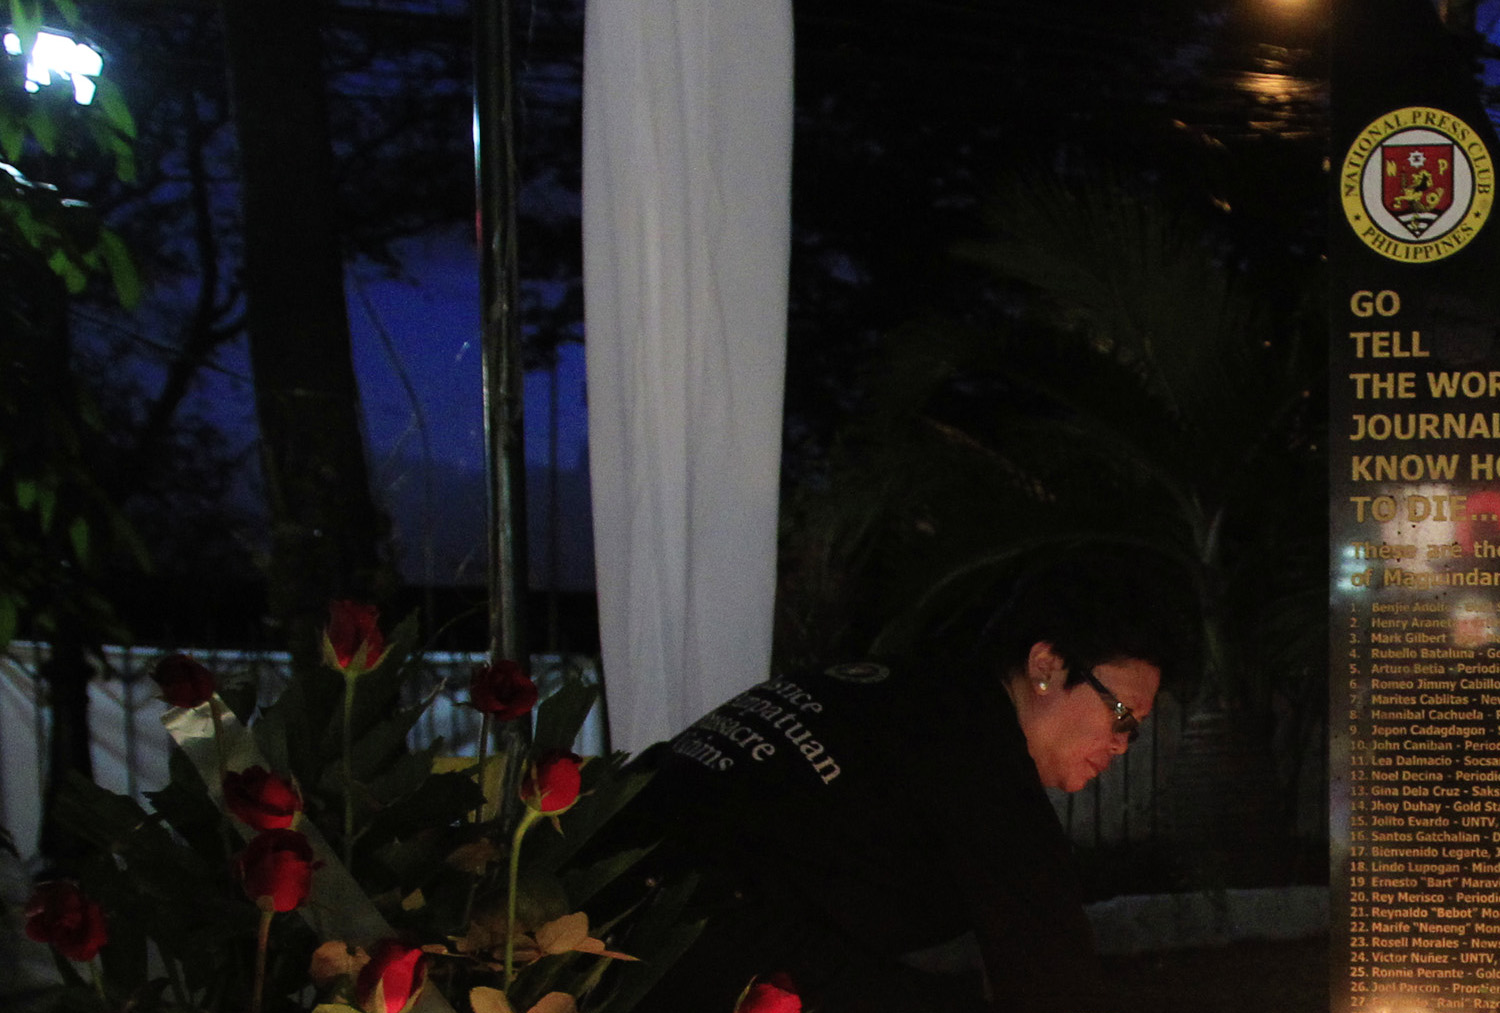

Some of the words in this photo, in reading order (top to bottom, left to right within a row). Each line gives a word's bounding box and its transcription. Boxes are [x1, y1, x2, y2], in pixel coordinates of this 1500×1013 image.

[1345, 115, 1404, 196] NATIONAL
[1412, 111, 1470, 141] PRESS
[1468, 142, 1491, 194] CLUB
[1362, 223, 1473, 259] PHILIPPINES
[1350, 290, 1401, 317] GO
[1350, 331, 1430, 358] TELL
[1349, 372, 1416, 399] THE
[1352, 454, 1459, 481] KNOW
[1350, 496, 1397, 523] TO
[1407, 495, 1499, 522] DIE...
[1351, 542, 1418, 560] These
[1427, 545, 1462, 559] are
[1351, 569, 1373, 586] of
[1421, 648, 1474, 660] Bataluna
[1371, 663, 1408, 674] Arturo
[1414, 663, 1445, 675] Betia
[1371, 678, 1413, 689] Romeo
[1418, 678, 1456, 692] Jimmy
[1461, 678, 1500, 690] Cabillo
[1371, 694, 1417, 705] Marites
[1421, 694, 1469, 706] Cablitas
[1371, 709, 1424, 720] Hannibal
[1430, 709, 1483, 721] Cachuela
[1372, 725, 1406, 739] Jepon
[1411, 725, 1485, 739] Cadagdagon
[1371, 740, 1399, 751] John
[1404, 740, 1452, 752] Caniban
[1371, 755, 1392, 766] Lea
[1396, 755, 1451, 767] Dalmacio
[1371, 770, 1399, 781] Noel
[1402, 770, 1443, 782] Decina
[1371, 785, 1399, 796] Gina
[1403, 785, 1429, 797] Dela
[1433, 786, 1460, 797] Cruz
[1372, 800, 1398, 814] Jhoy
[1403, 800, 1441, 814] Duhay
[1454, 801, 1482, 812] Gold
[1372, 815, 1404, 826] Jolito
[1408, 815, 1449, 827] Evardo
[1371, 831, 1412, 842] Santos
[1418, 832, 1479, 843] Gatchalian
[1371, 846, 1438, 857] Bienvenido
[1372, 862, 1404, 873] Lindo
[1409, 863, 1459, 877] Lupogan
[1371, 906, 1428, 920] Reynaldo
[1372, 921, 1411, 932] Marife
[1372, 936, 1407, 947] Rosell
[1412, 937, 1459, 948] Morales
